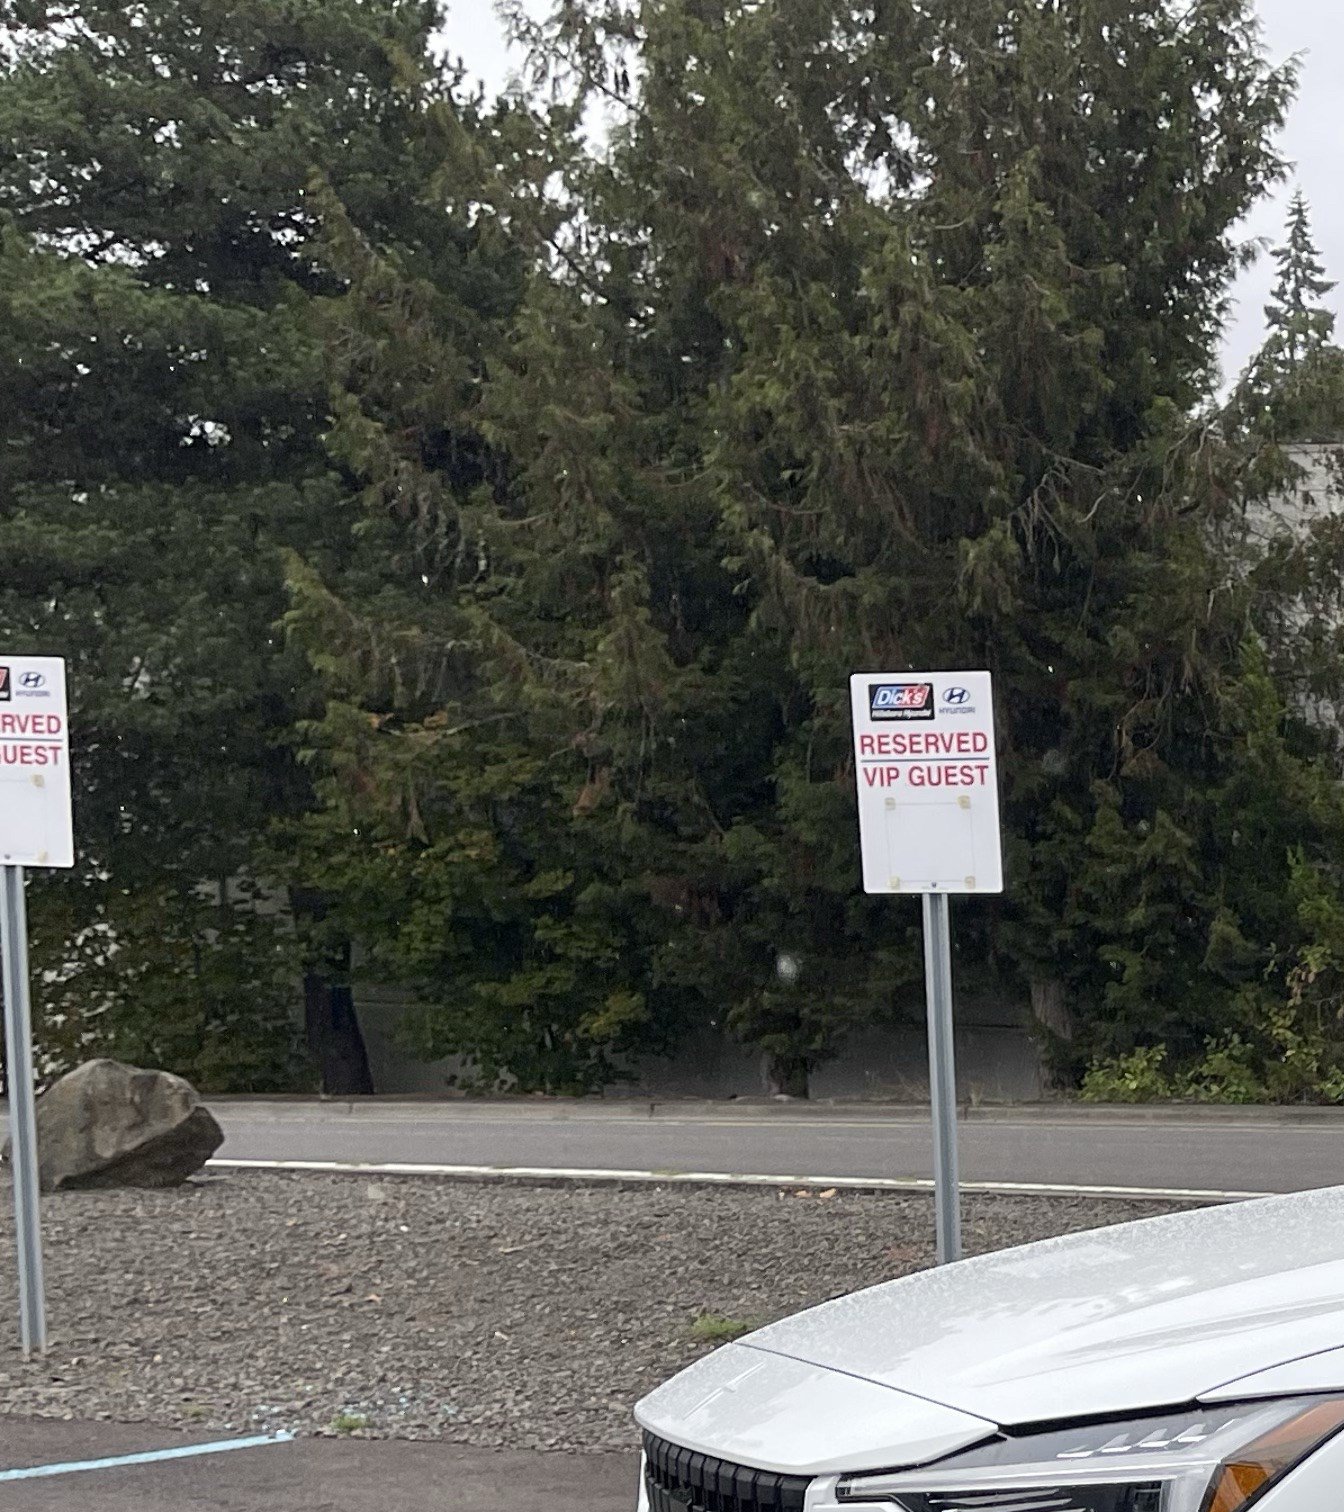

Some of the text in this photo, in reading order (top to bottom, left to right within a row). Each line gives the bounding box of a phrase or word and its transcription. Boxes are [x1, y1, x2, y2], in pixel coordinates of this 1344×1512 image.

[860, 732, 988, 755] RESERVED
[0, 745, 62, 765] UEST
[864, 765, 989, 787] VIP GUEST
